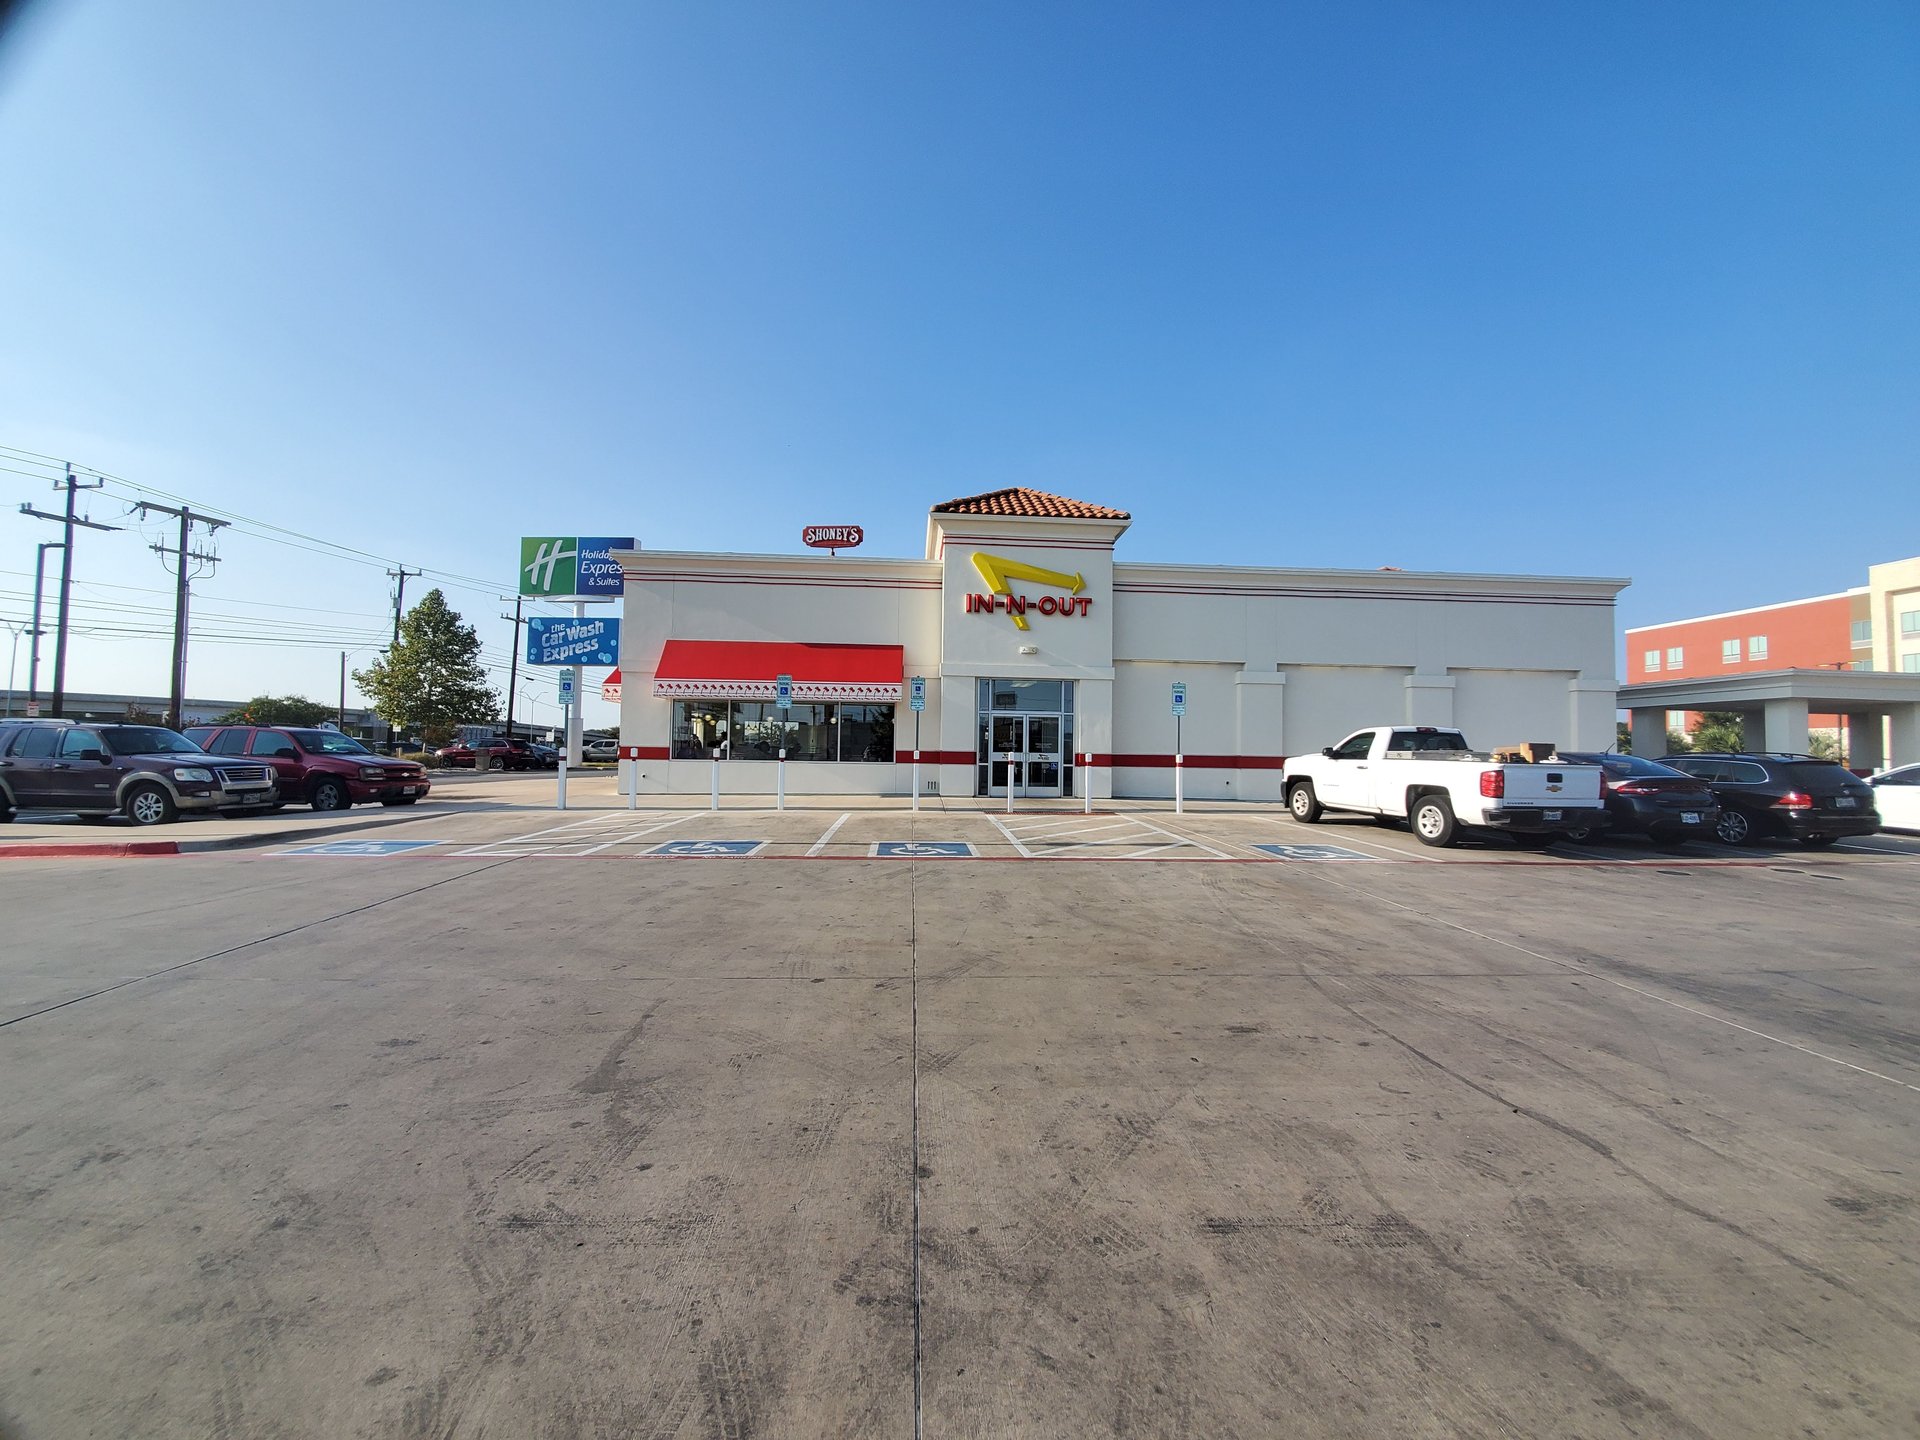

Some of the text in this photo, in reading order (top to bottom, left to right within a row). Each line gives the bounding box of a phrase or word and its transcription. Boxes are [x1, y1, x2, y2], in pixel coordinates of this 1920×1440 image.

[806, 526, 859, 543] SHONEY'S
[588, 577, 620, 586] & Suites
[966, 593, 1093, 617] IN-N-OUT
[541, 620, 604, 648] Car Wash
[551, 623, 566, 633] the
[543, 638, 599, 662] Express
